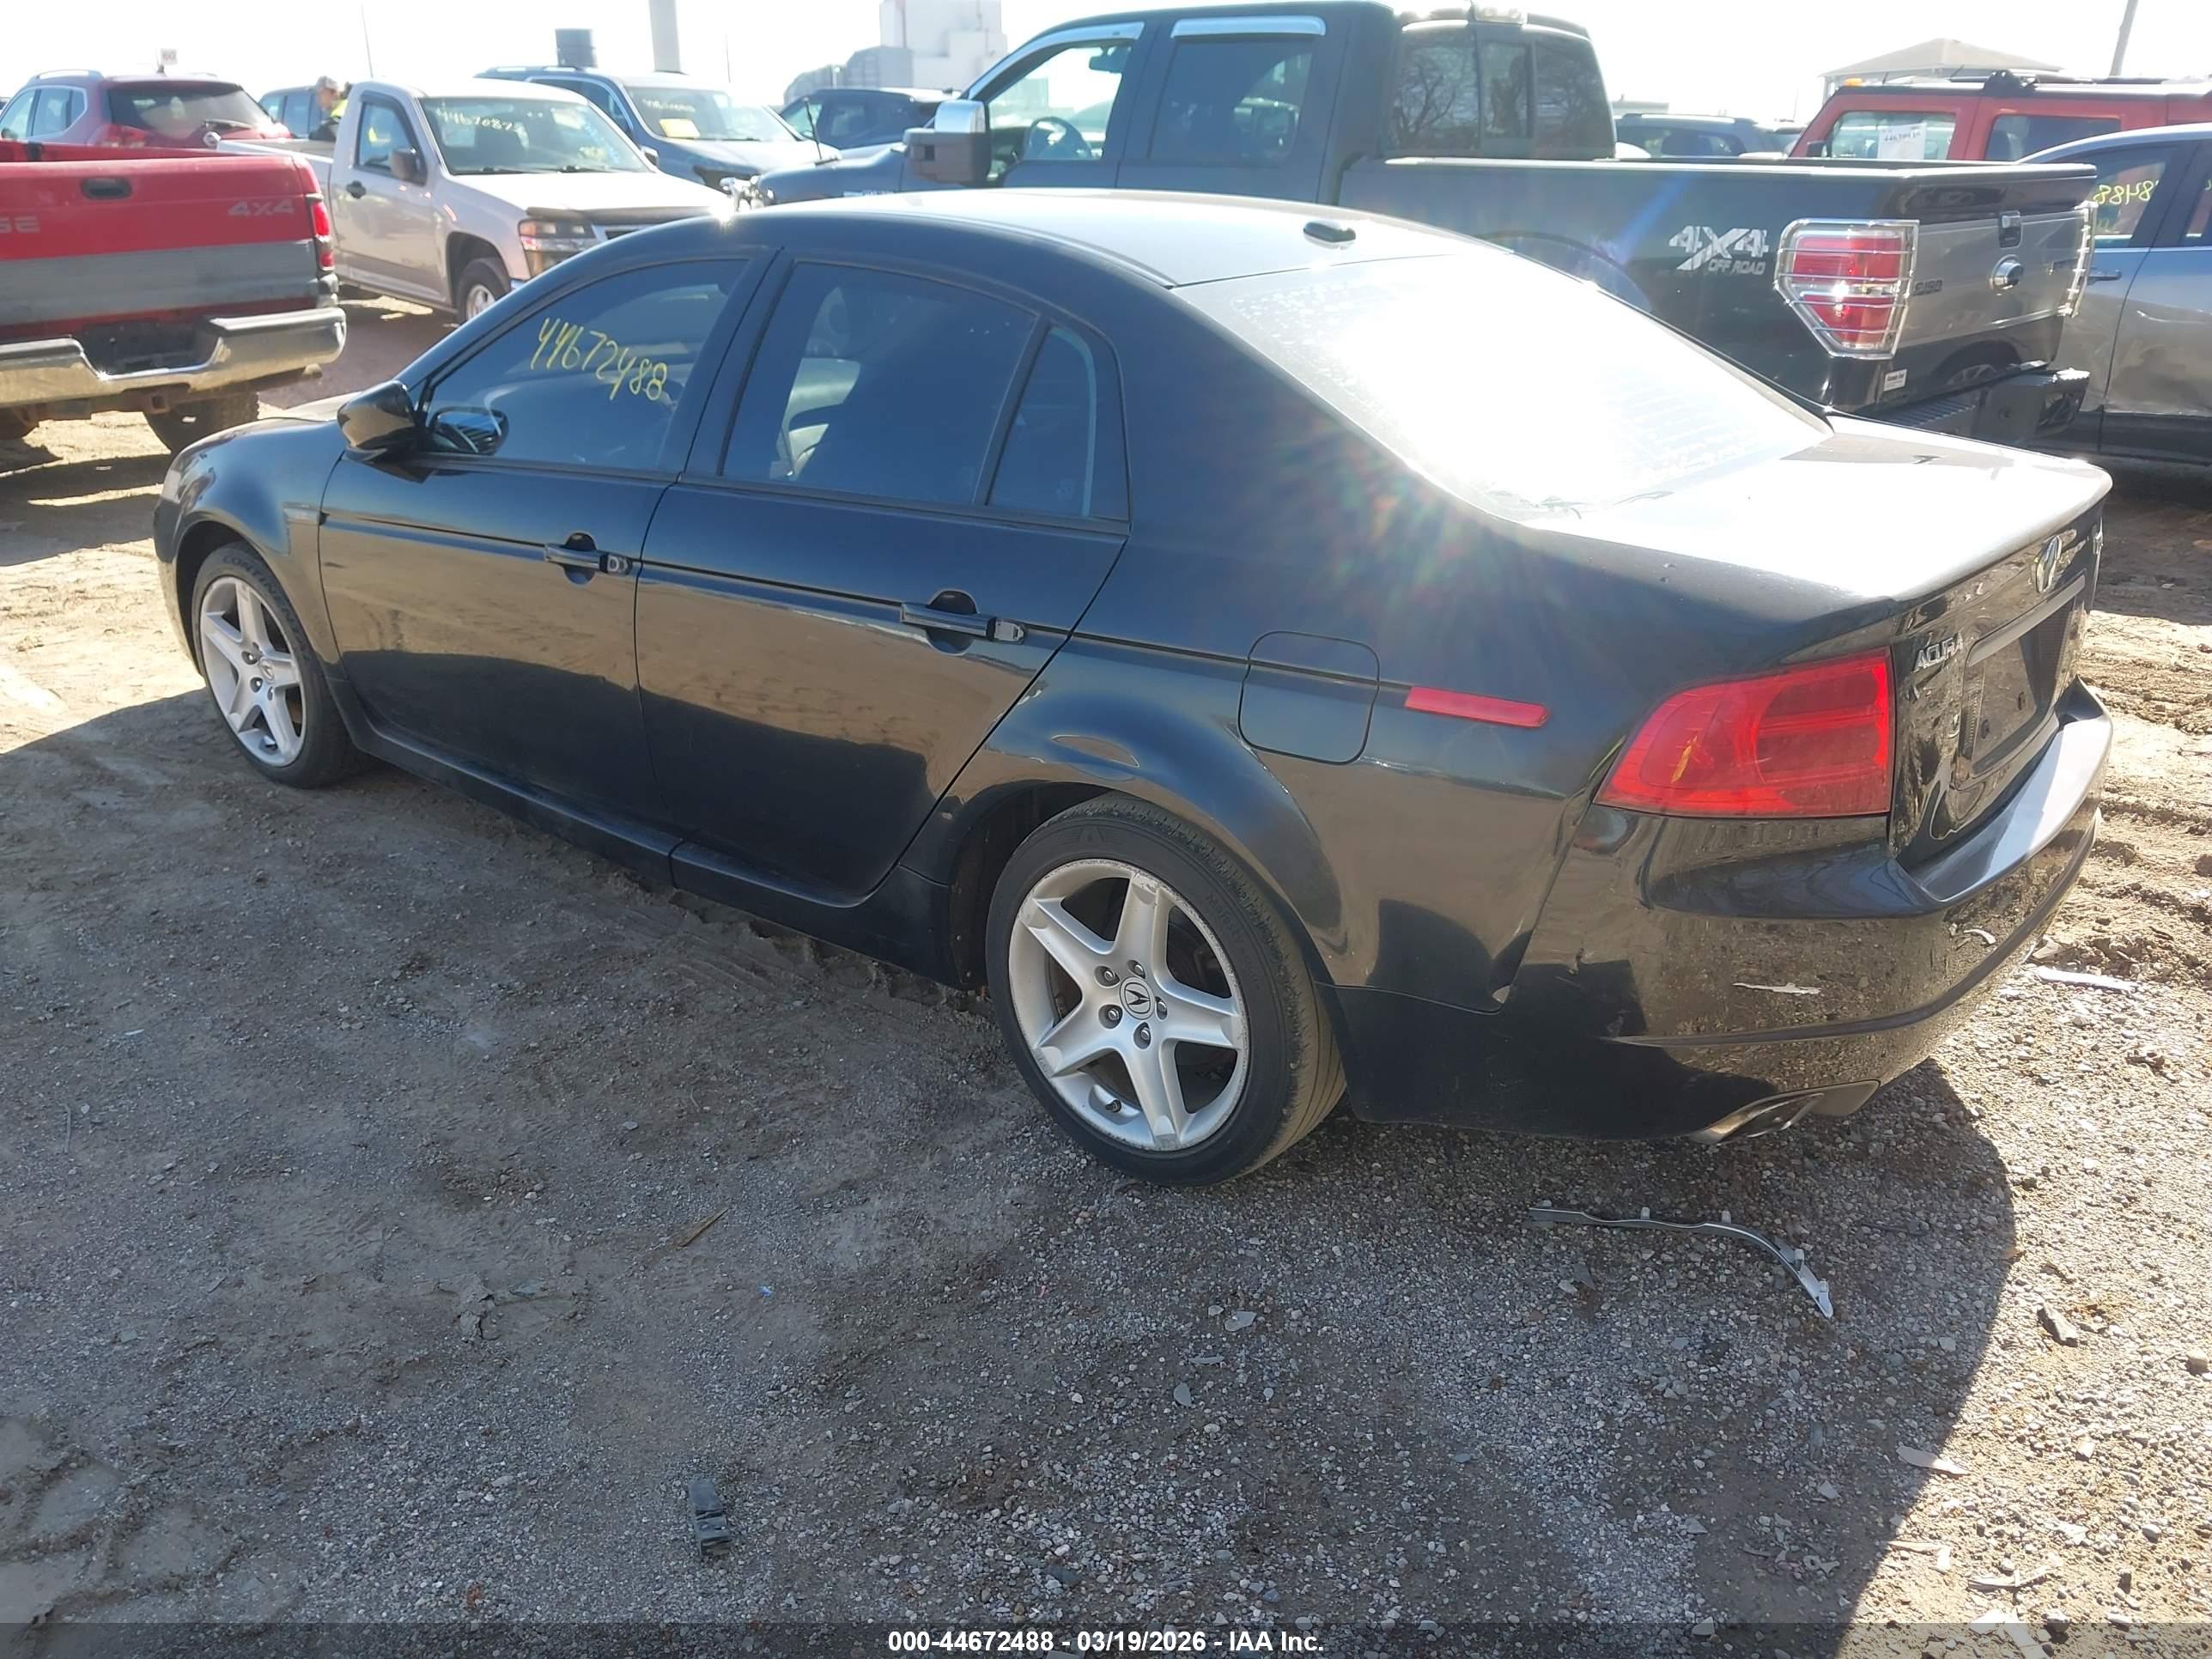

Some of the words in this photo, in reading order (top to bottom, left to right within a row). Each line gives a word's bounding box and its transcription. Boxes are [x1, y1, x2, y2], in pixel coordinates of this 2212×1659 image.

[1708, 258, 1732, 272] OFF
[1731, 260, 1766, 275] ROAD
[530, 317, 668, 400] 44672488
[1911, 631, 1964, 673] ACURA
